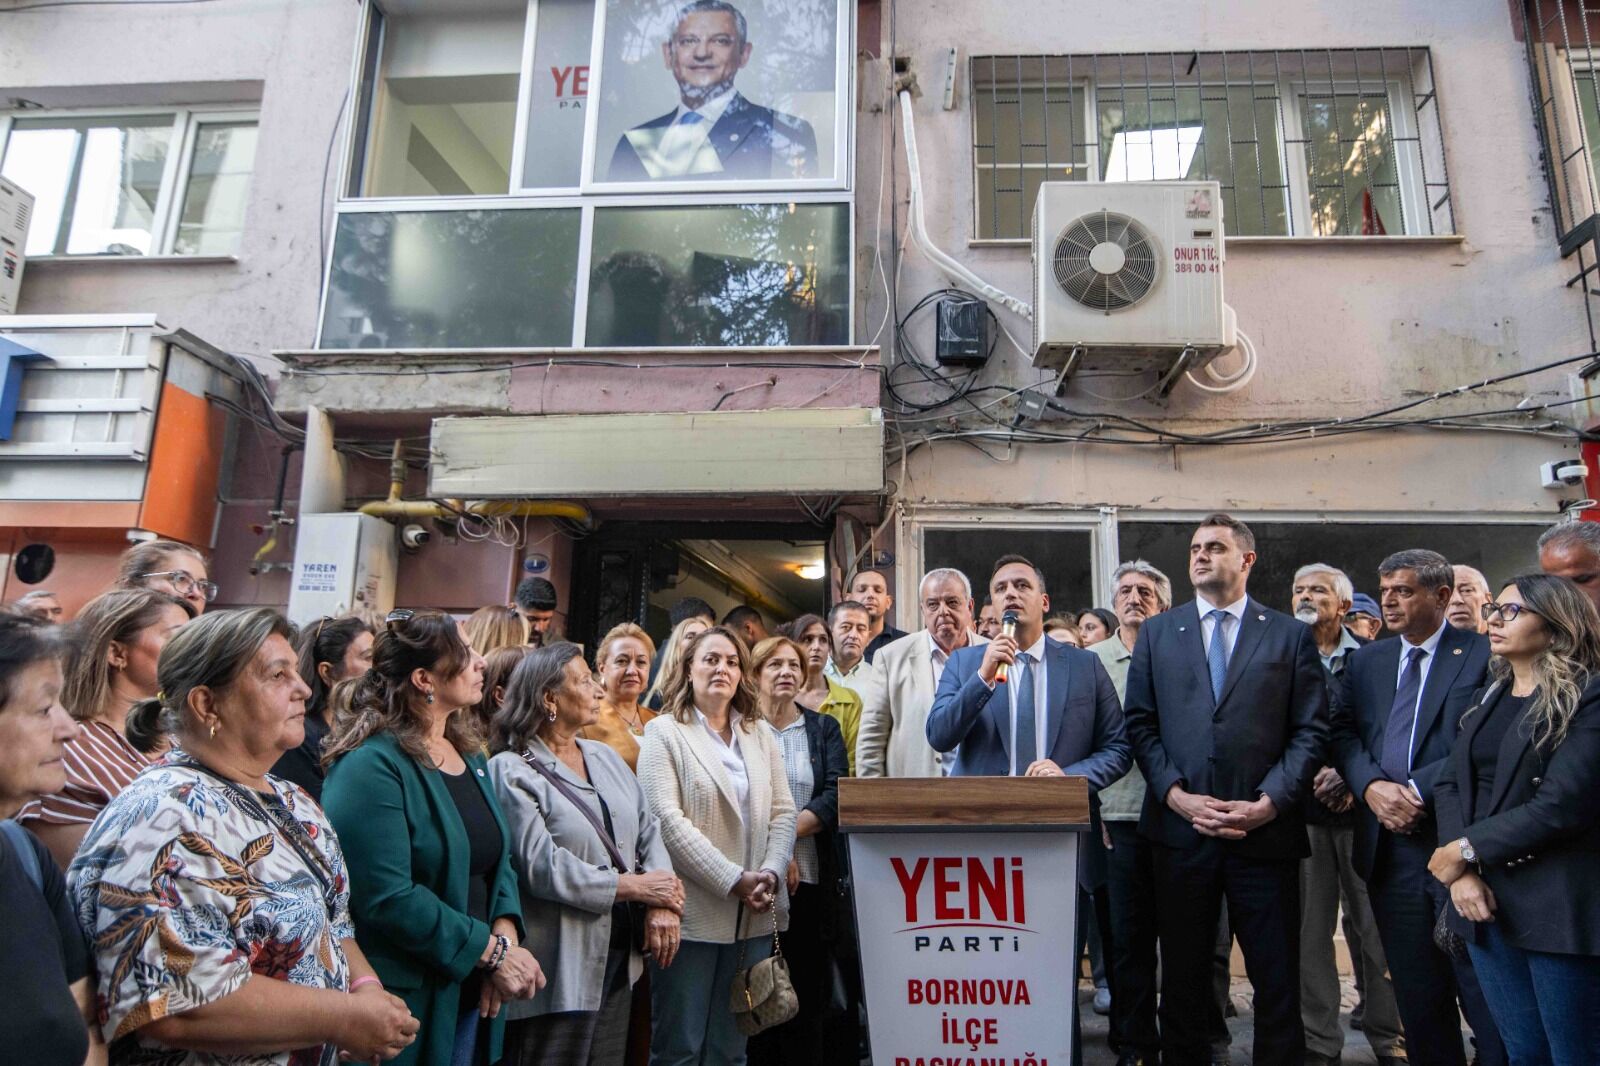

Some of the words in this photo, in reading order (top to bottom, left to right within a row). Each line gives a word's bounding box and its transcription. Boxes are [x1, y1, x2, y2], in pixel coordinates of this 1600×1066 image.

[1174, 247, 1200, 260] ONUR
[1195, 263, 1206, 273] 00
[1209, 263, 1219, 273] 41
[303, 563, 337, 572] YAREN
[908, 979, 1031, 1005] BORNOVA
[942, 1012, 998, 1051] İLÇE
